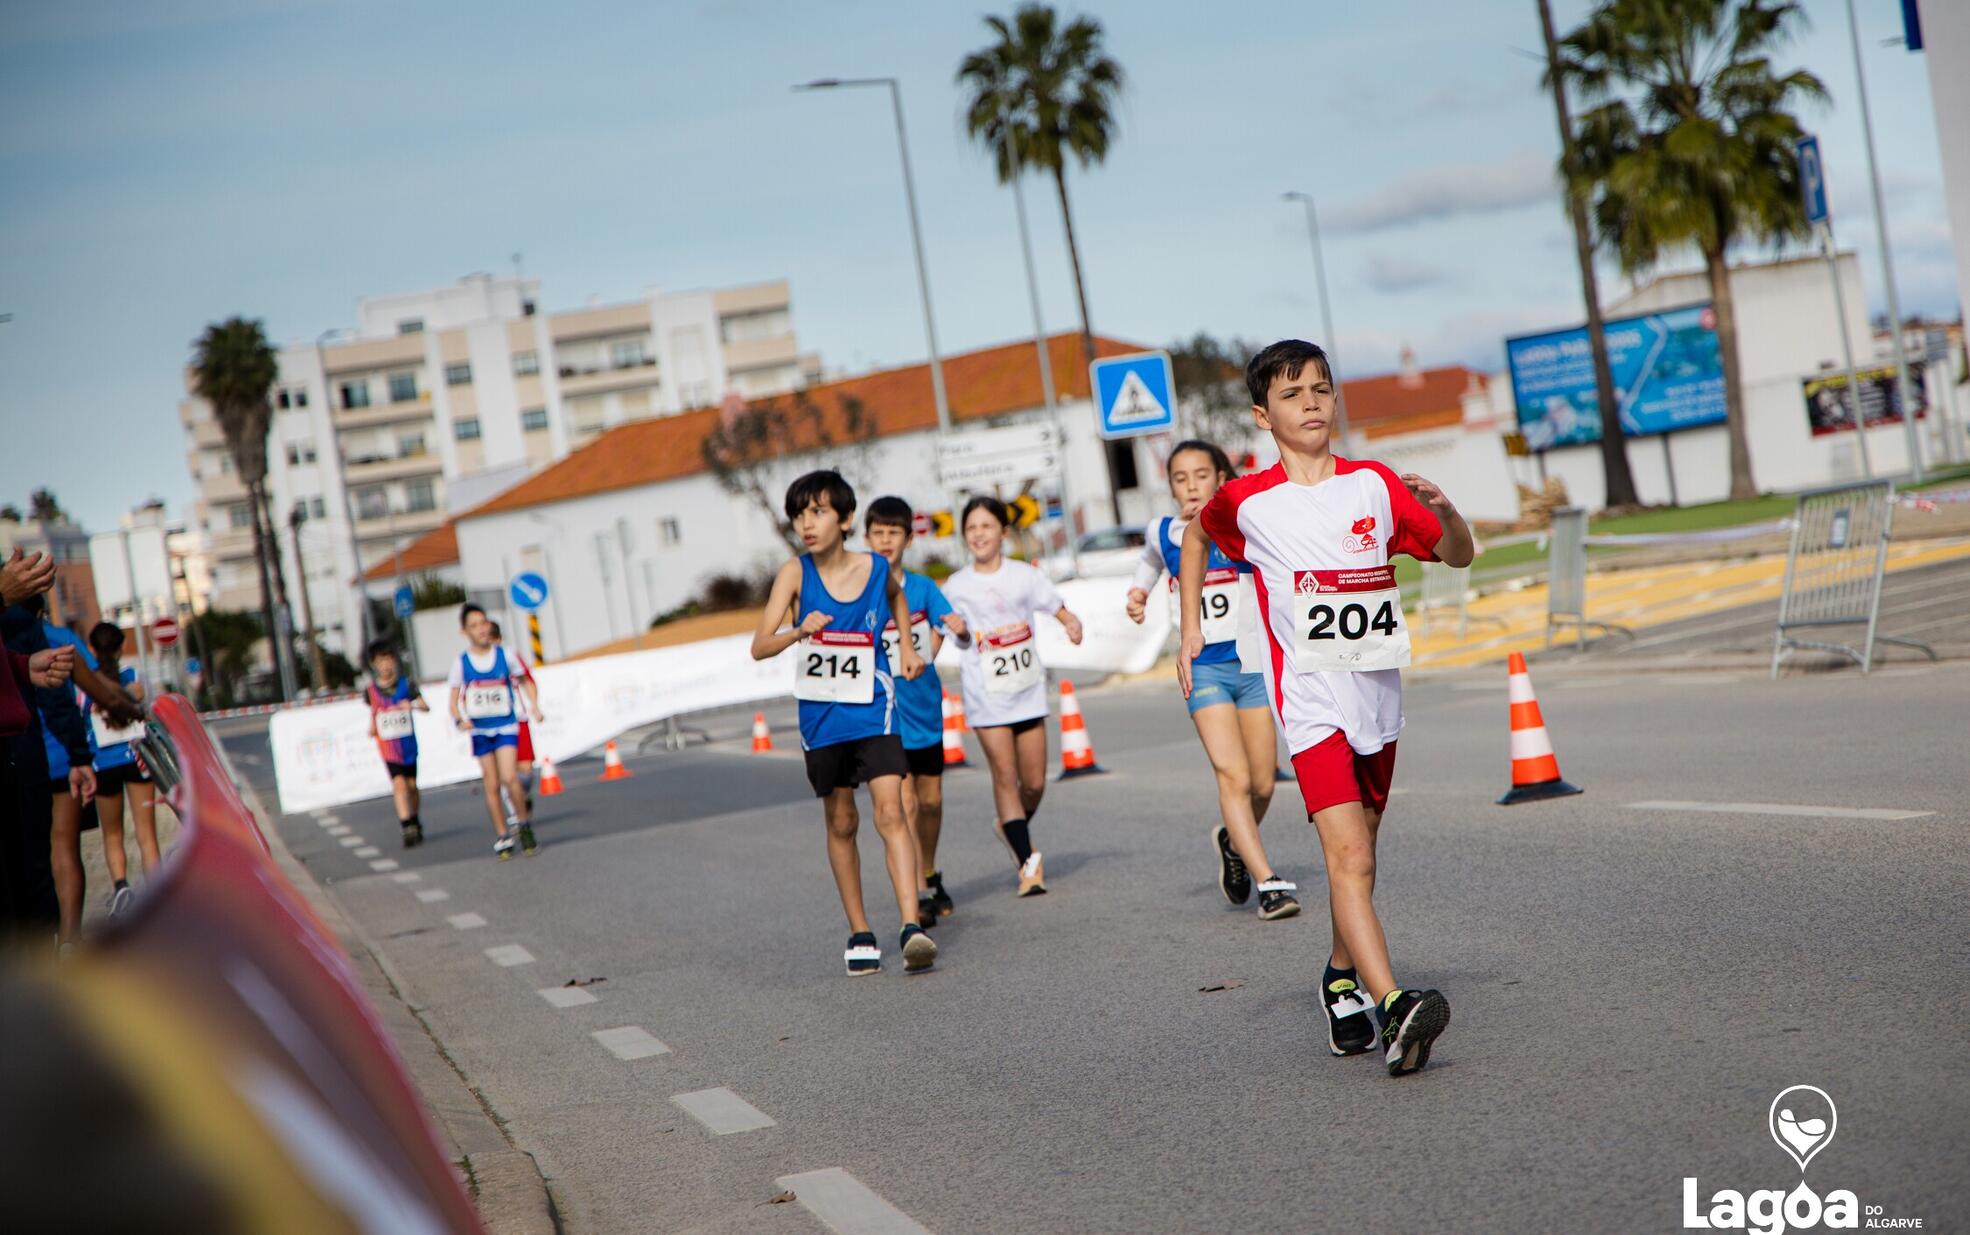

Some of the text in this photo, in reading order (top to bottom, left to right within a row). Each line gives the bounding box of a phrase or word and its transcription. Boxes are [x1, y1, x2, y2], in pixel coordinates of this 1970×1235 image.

[1338, 571, 1374, 579] CAMPEONATO
[1201, 593, 1229, 619] 19
[1307, 600, 1398, 640] 204
[807, 653, 861, 678] 214
[993, 648, 1031, 676] 210
